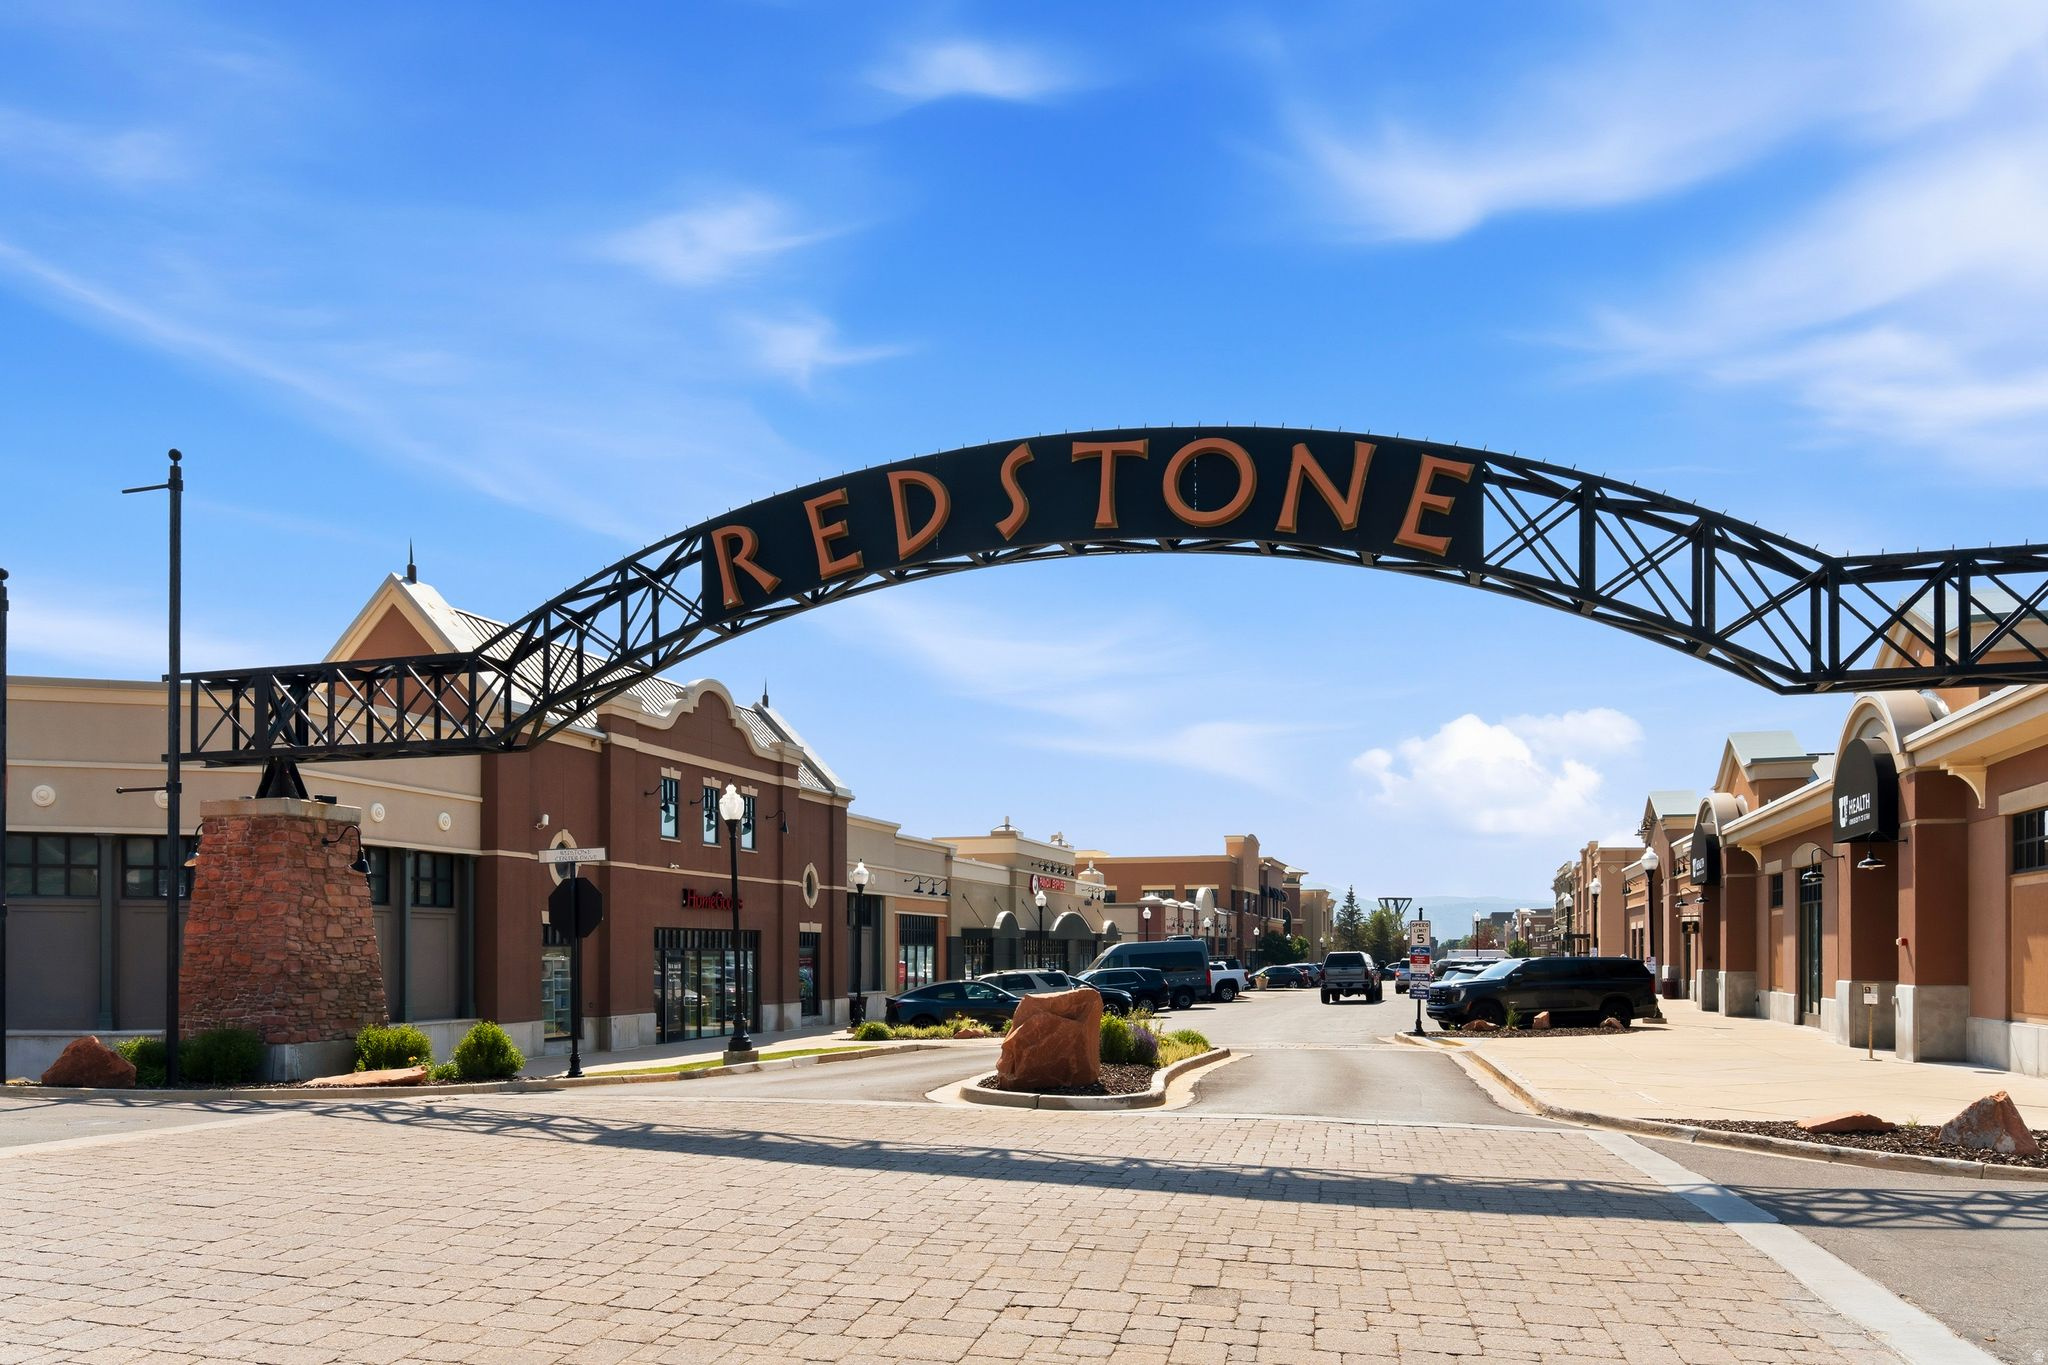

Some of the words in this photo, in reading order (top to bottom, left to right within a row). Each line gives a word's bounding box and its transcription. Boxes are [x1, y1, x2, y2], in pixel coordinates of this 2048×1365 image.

[711, 437, 1475, 609] REDSTONE
[1849, 793, 1870, 815] HEALTH
[682, 888, 744, 910] HomeGoos
[1417, 934, 1425, 944] 5
